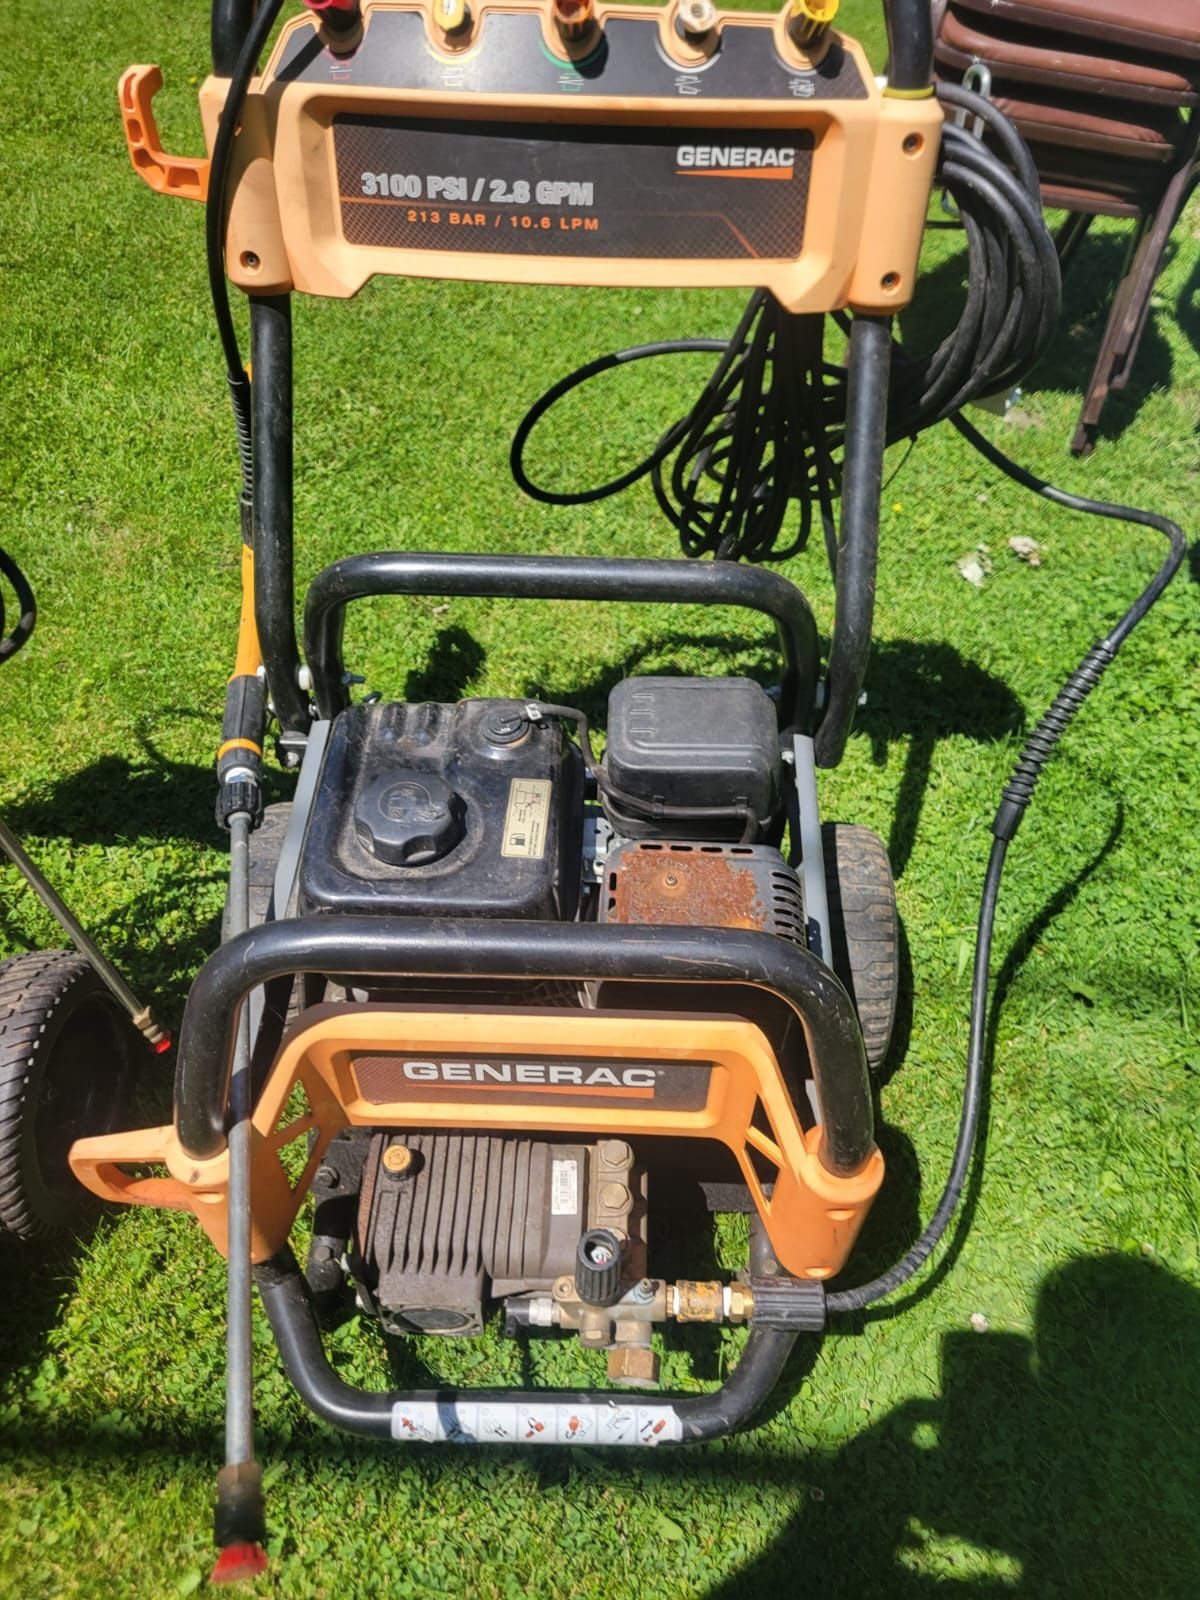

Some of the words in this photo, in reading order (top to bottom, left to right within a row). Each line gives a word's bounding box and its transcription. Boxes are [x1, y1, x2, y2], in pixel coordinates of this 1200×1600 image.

[676, 145, 795, 167] GENERAC
[361, 172, 421, 198] 3100
[427, 175, 467, 200] PSI
[472, 178, 485, 201] /
[489, 179, 530, 204] 2.8
[535, 181, 594, 206] GPM
[407, 210, 441, 223] 213
[449, 212, 486, 226] BAR
[494, 215, 501, 227] /
[510, 216, 551, 229] 10.6
[560, 218, 599, 230] LPM
[403, 1061, 656, 1087] GENERAC
